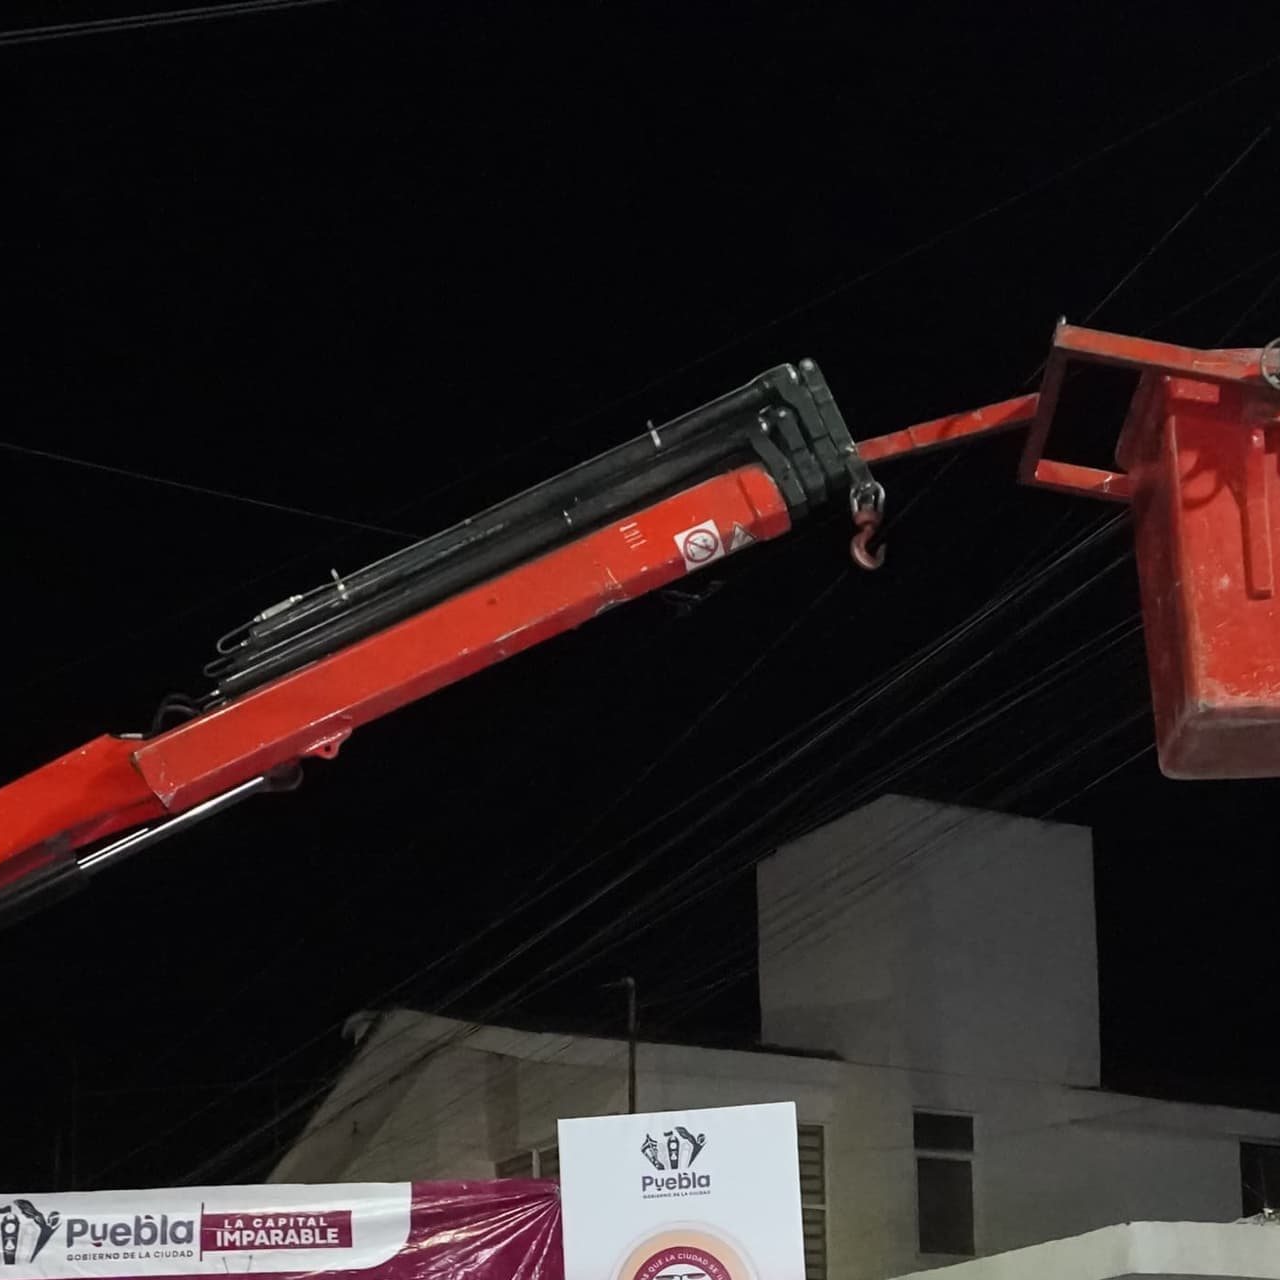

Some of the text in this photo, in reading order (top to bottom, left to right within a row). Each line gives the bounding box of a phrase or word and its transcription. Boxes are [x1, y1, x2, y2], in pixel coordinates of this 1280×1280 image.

[642, 1171, 711, 1192] Puebla
[224, 1216, 328, 1229] LA CAPITAL
[66, 1214, 195, 1248] Puebla
[216, 1228, 339, 1247] IMPARABLE
[66, 1252, 120, 1261] GOBIERNO
[122, 1251, 136, 1259] DE
[153, 1250, 194, 1258] CIUDAD
[677, 1253, 709, 1266] CIUDAD
